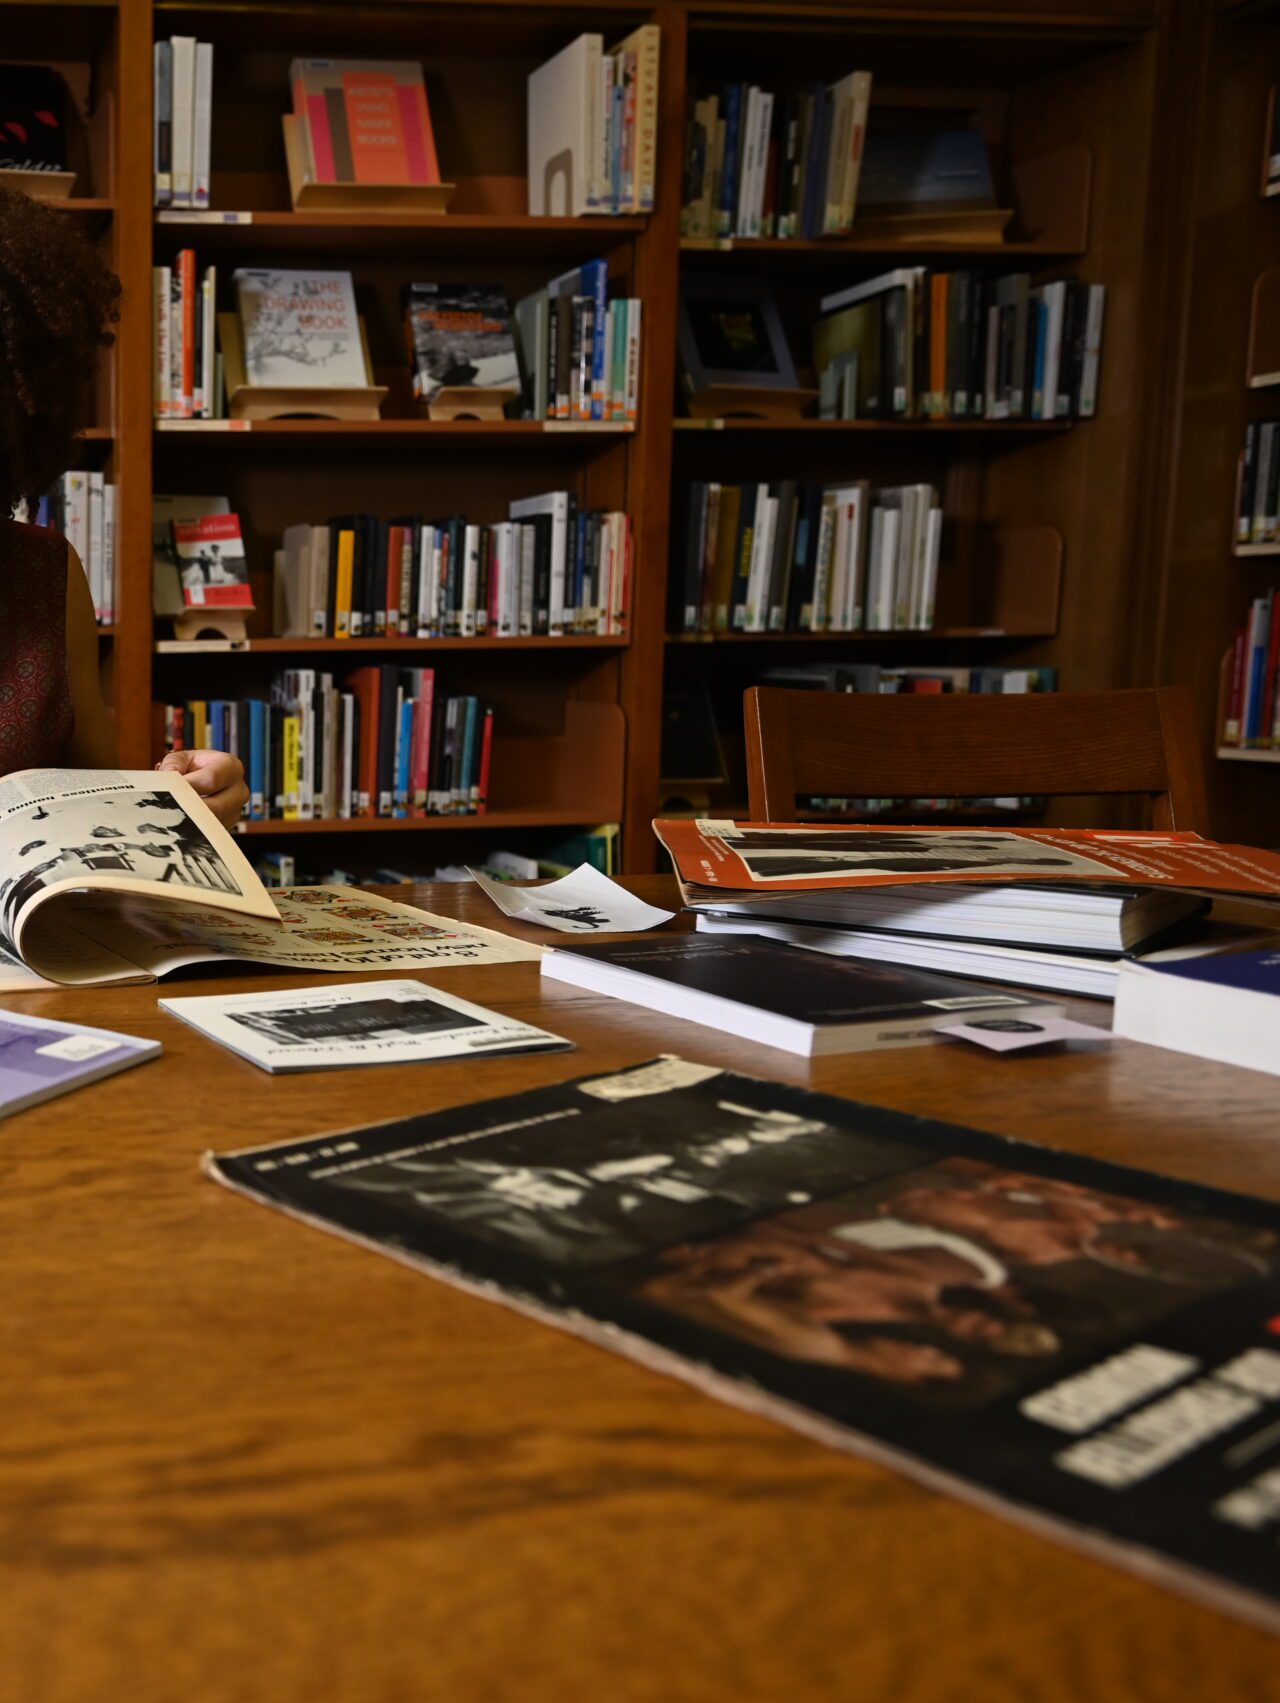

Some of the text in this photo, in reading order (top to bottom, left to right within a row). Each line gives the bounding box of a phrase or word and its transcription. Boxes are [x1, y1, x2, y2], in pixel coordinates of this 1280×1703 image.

[357, 134, 399, 145] BOOKS
[311, 279, 343, 293] THE
[262, 296, 346, 312] DRAWING
[298, 314, 348, 330] BOOK
[61, 784, 136, 798] Relentless
[7, 795, 56, 814] honing
[278, 942, 490, 959] new homes have
[405, 952, 452, 960] out
[454, 950, 480, 958] 8
[342, 956, 379, 964] 10
[374, 954, 405, 963] of
[374, 1038, 421, 1050] Might
